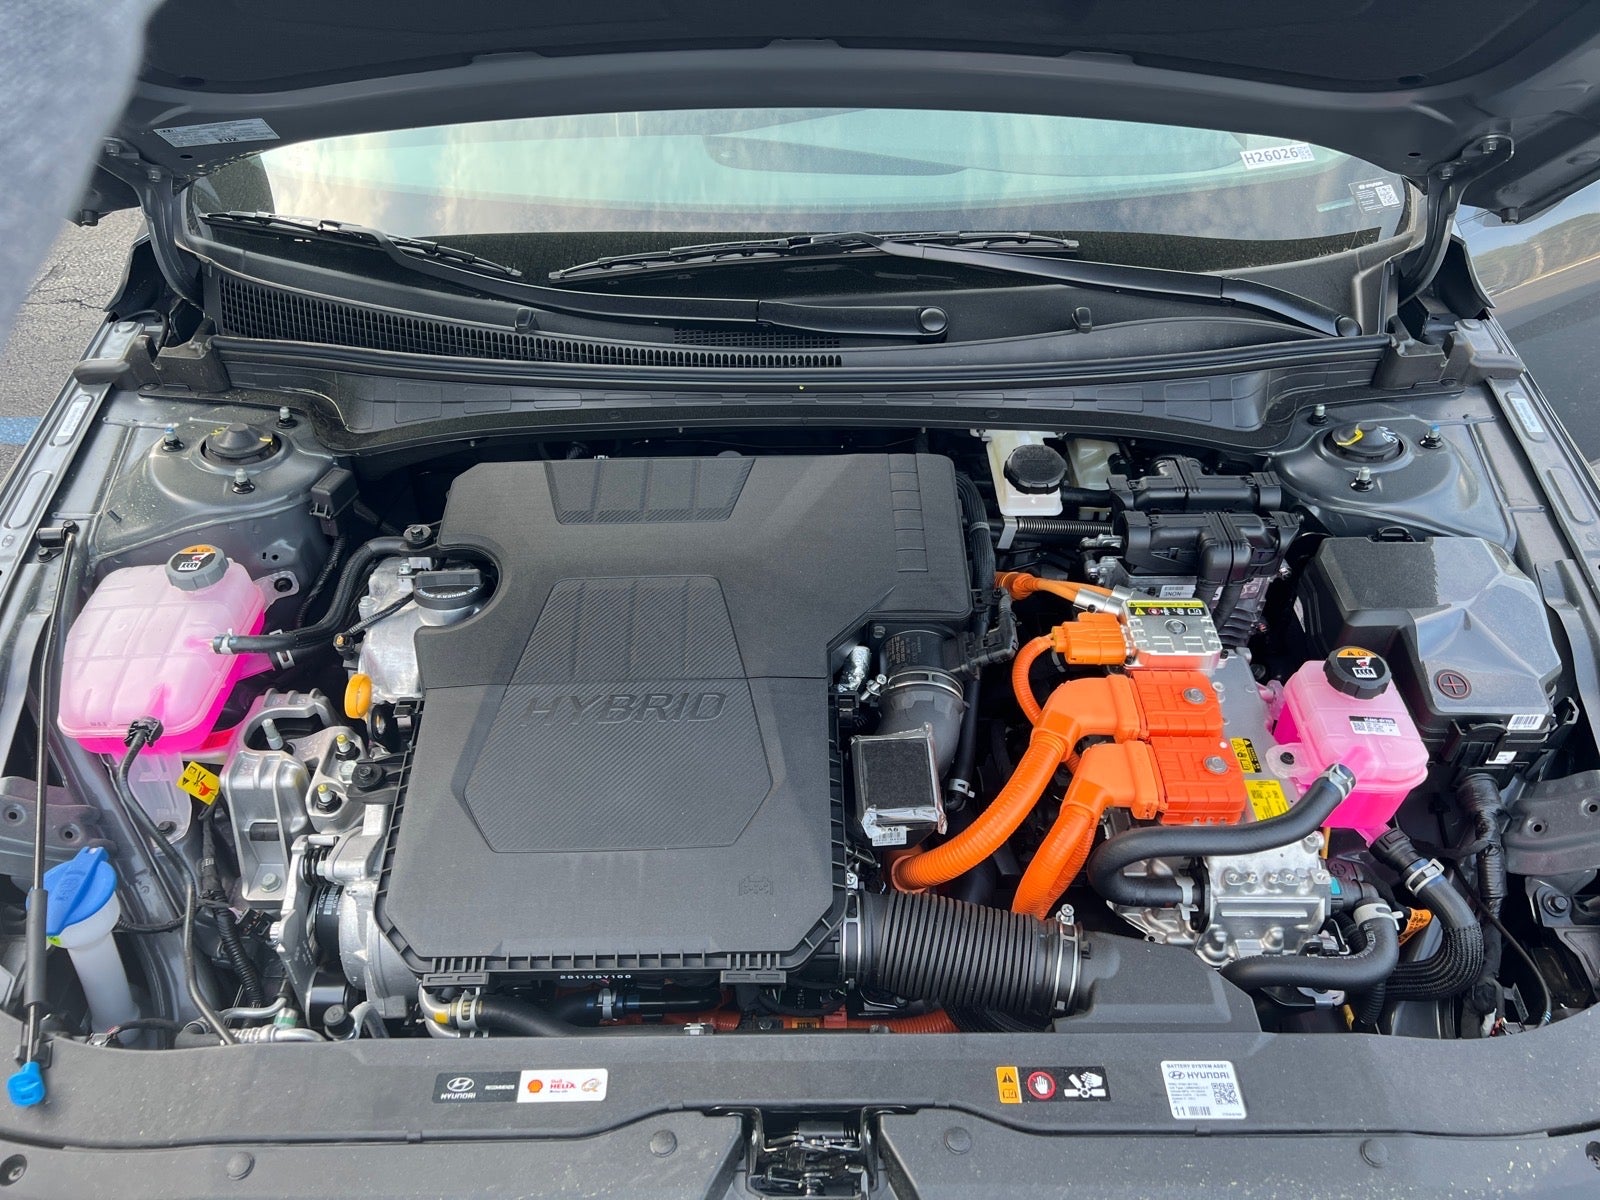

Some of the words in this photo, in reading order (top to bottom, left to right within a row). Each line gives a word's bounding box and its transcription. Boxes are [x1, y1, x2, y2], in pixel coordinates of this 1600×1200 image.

[1244, 147, 1298, 164] H26026
[519, 692, 727, 726] HYBRID
[440, 1092, 476, 1100] HYUNDAI
